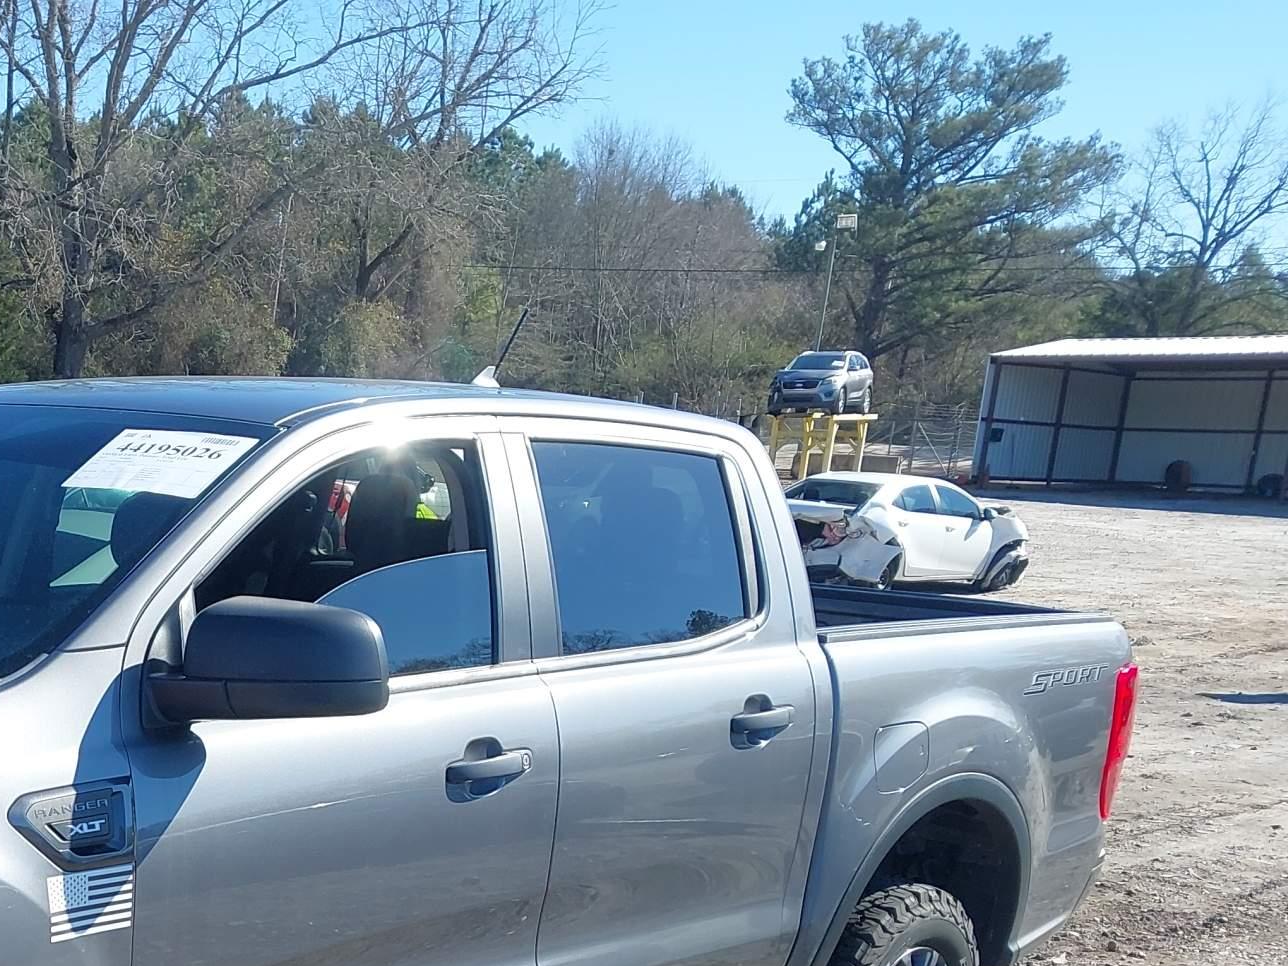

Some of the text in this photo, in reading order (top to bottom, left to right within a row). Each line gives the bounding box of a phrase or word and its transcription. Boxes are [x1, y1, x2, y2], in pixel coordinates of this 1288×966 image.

[116, 441, 223, 460] 44195026
[1023, 663, 1109, 696] SPORT
[34, 798, 108, 819] RANGER
[67, 819, 106, 836] XLT
